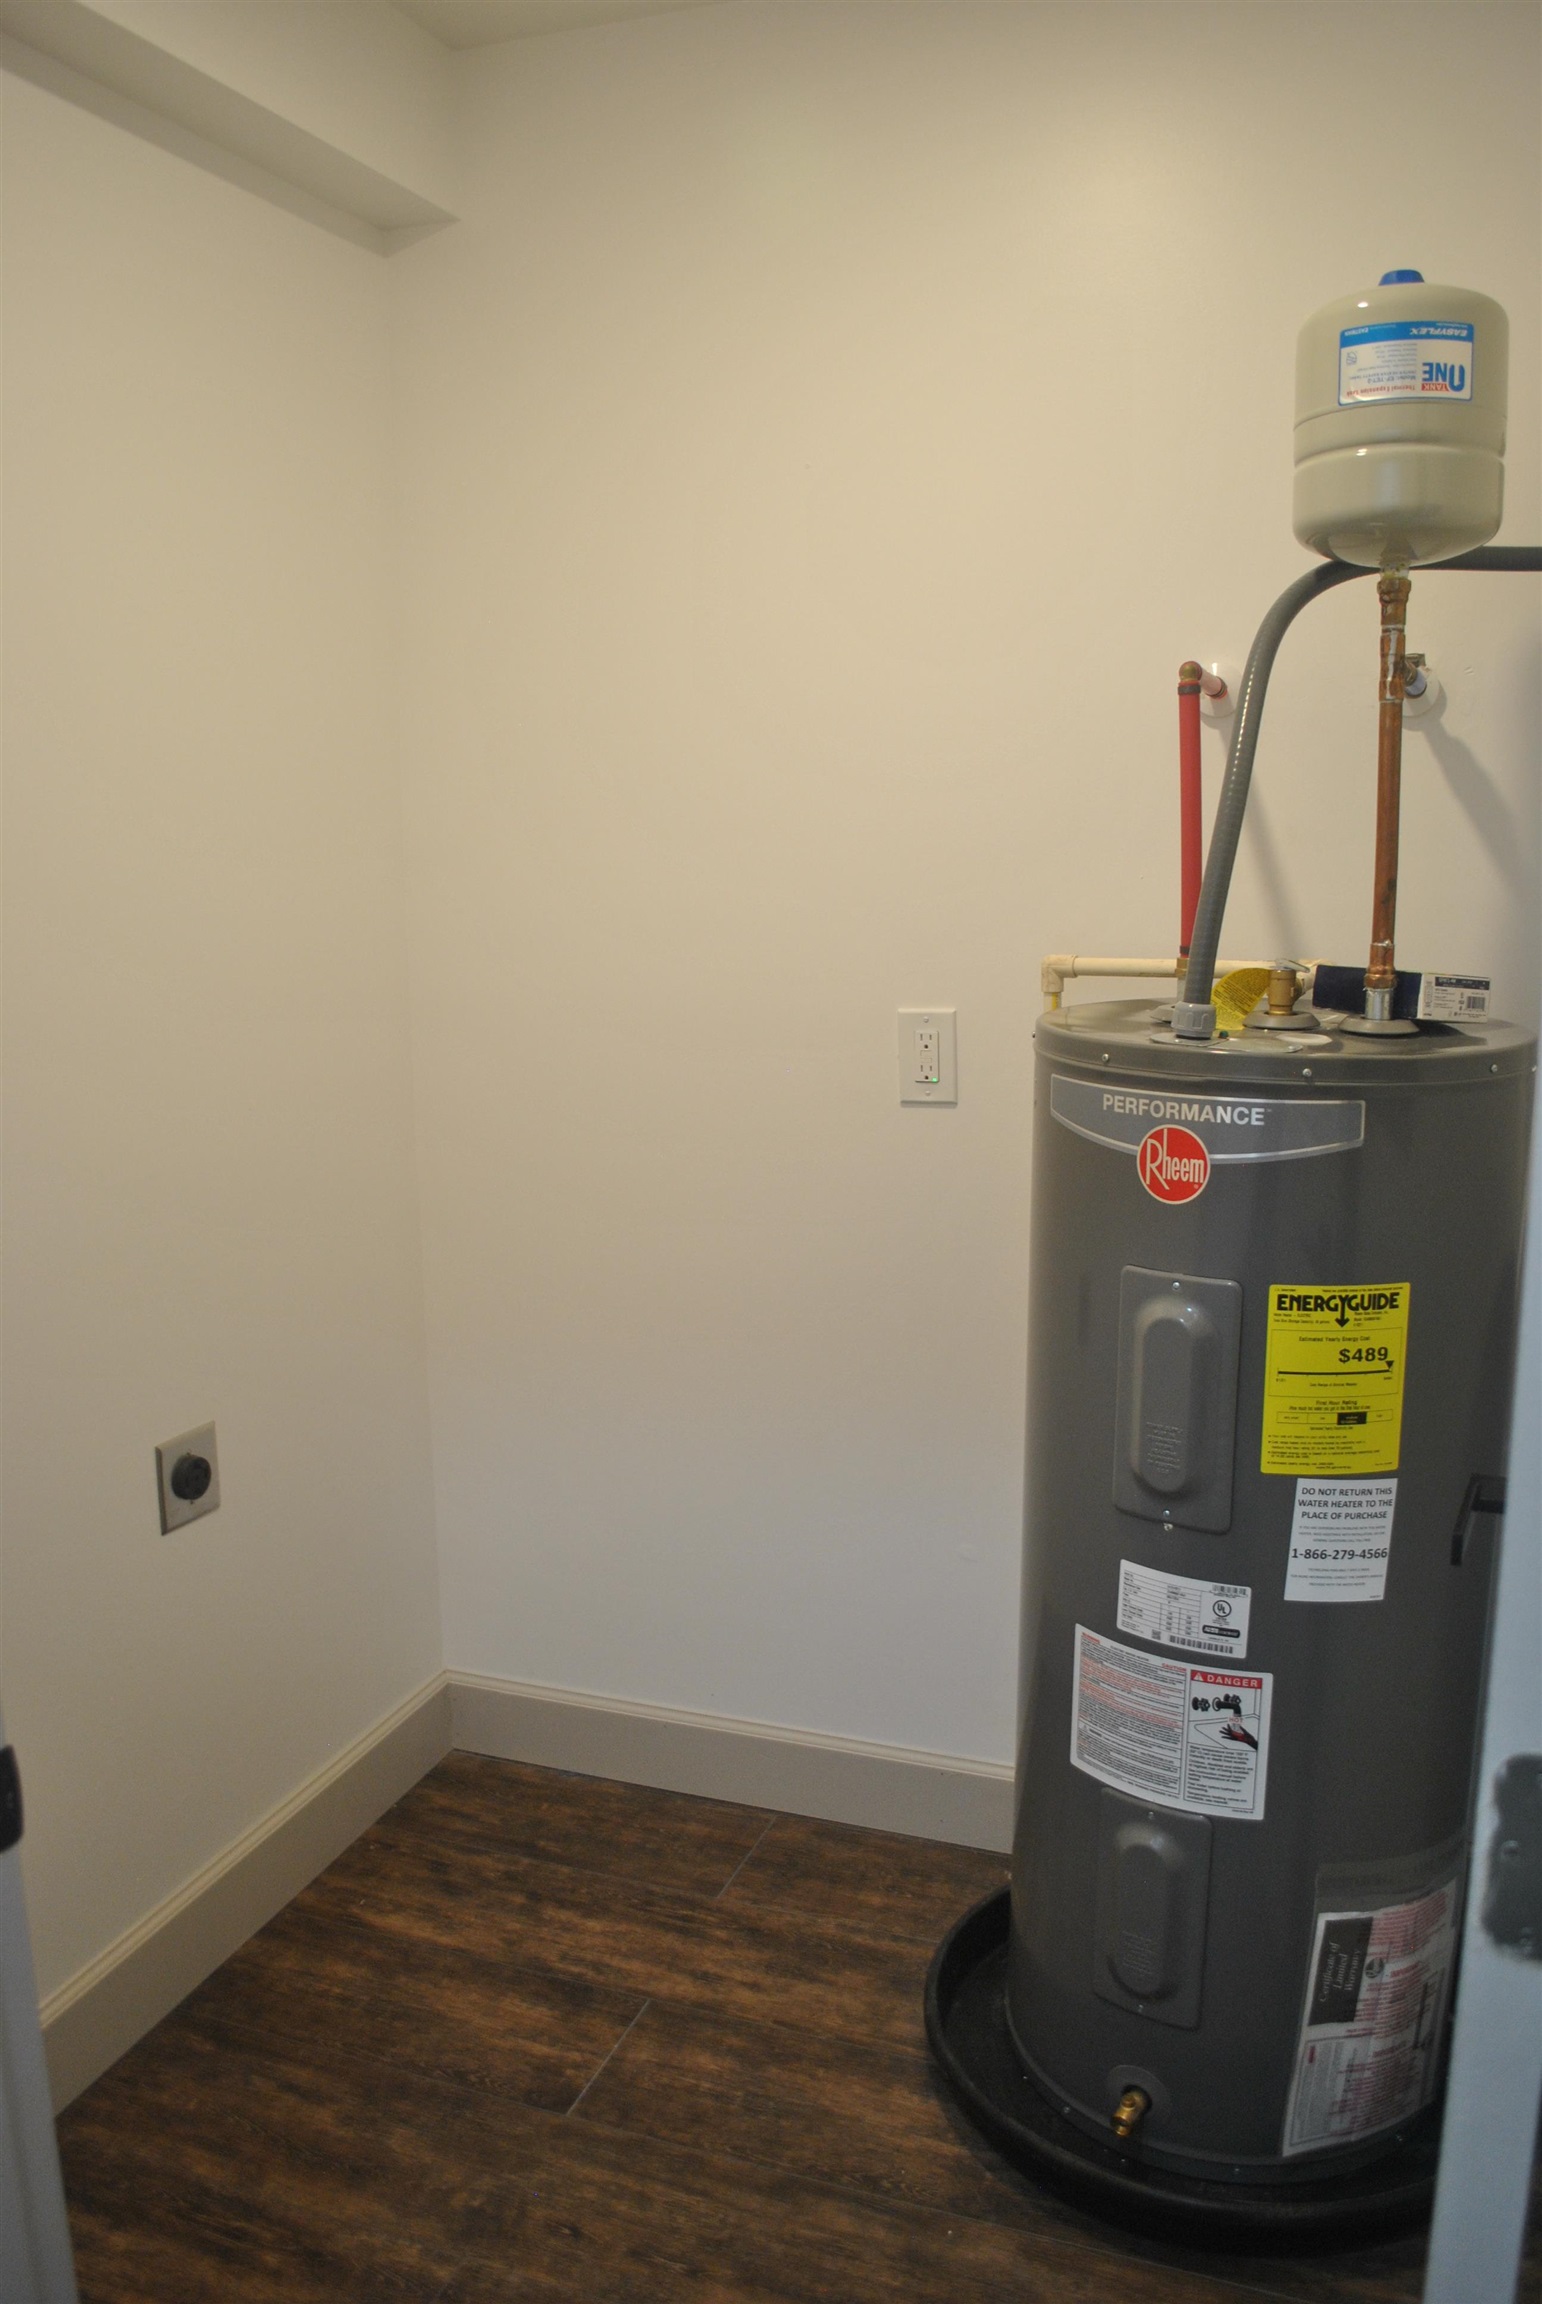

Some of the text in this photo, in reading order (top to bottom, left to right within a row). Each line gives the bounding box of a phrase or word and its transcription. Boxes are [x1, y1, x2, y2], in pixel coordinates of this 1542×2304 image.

[1409, 327, 1468, 337] EASYFLEX
[1423, 383, 1447, 391] TANK
[1102, 1093, 1265, 1126] PERFORMANCE
[1145, 1128, 1204, 1190] Rheem
[1276, 1291, 1400, 1313] ENERGYGUIDE
[1338, 1346, 1388, 1364] $489
[1301, 1486, 1392, 1496] DO NOT RETURN THIS
[1298, 1498, 1393, 1508] WATER HEATER TO THE
[1301, 1510, 1388, 1520] PLACE OF PURCHASE
[1291, 1547, 1388, 1560] 1-866-279-4566
[1206, 1674, 1258, 1688] DANGER
